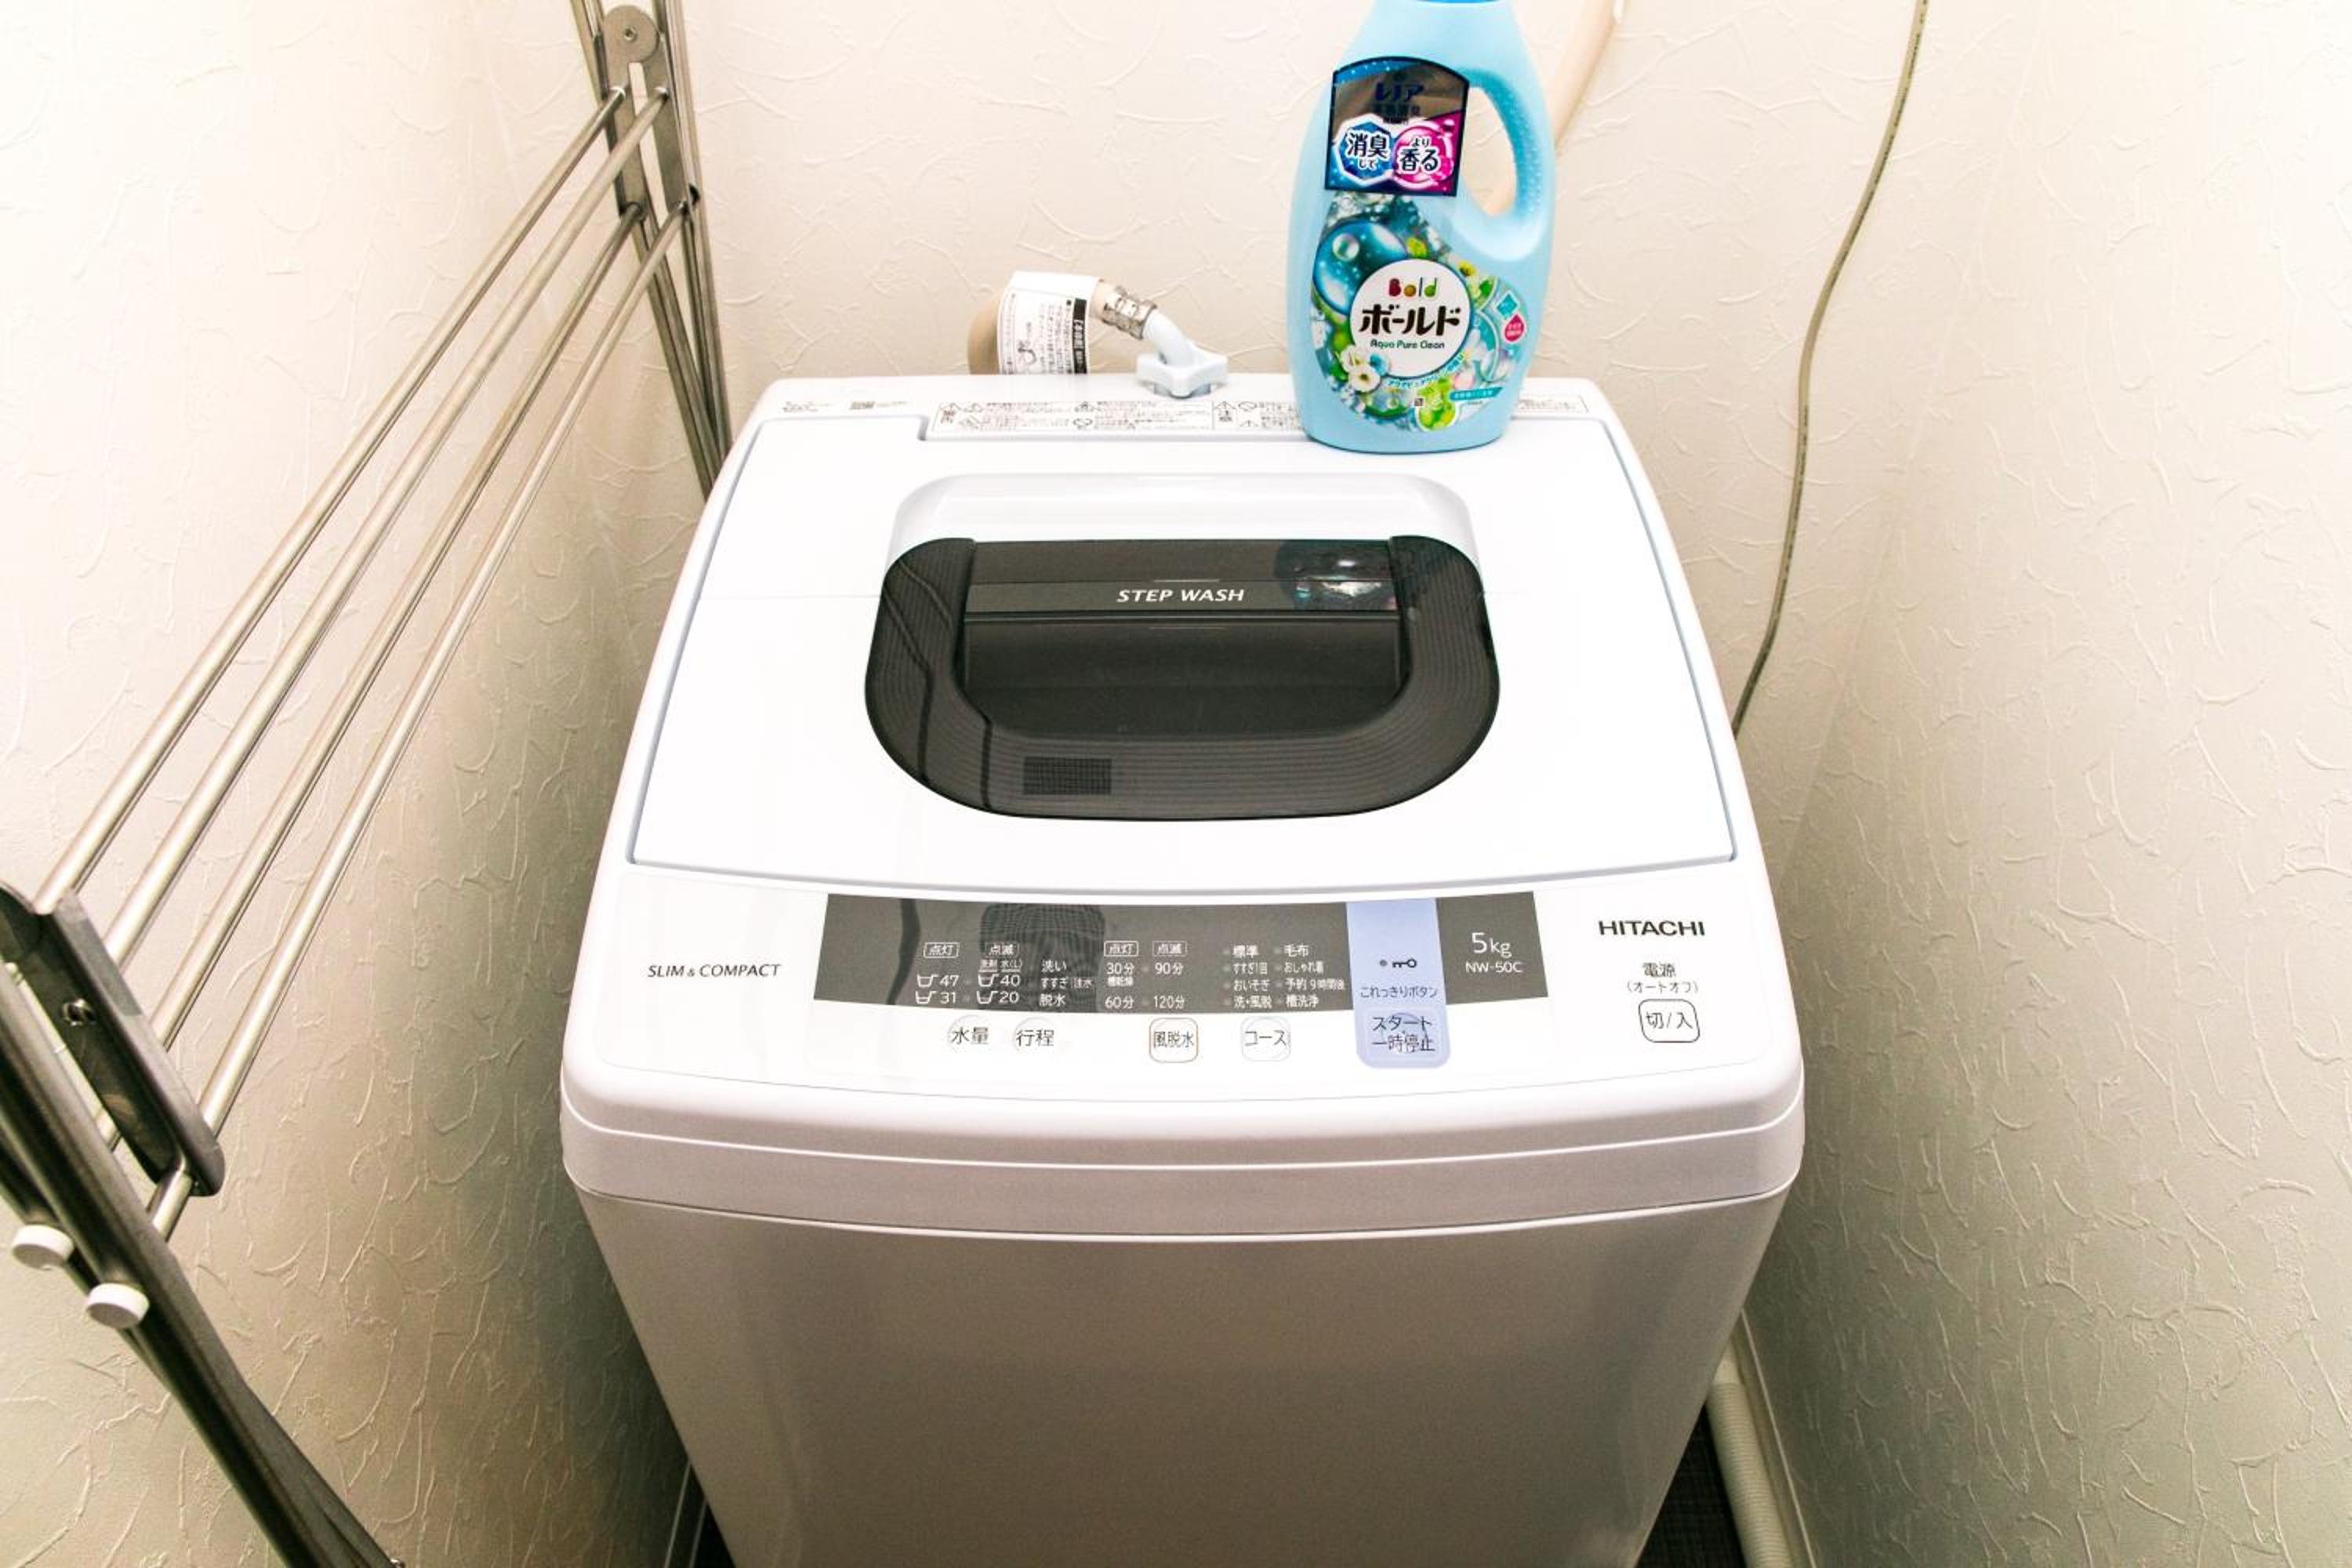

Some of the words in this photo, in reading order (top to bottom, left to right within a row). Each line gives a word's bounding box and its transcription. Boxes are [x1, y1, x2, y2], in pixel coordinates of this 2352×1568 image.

[1347, 132, 1389, 158] 消臭
[1413, 138, 1431, 147] より
[1359, 159, 1377, 169] して
[1400, 148, 1439, 171] 香る
[1388, 277, 1438, 297] Bold
[1359, 303, 1461, 336] ボールド
[1117, 589, 1173, 603] STEP
[1181, 589, 1244, 602] WASH
[1598, 920, 1706, 936] HITACHI
[648, 964, 684, 978] SLIM
[699, 964, 782, 978] COMPACT
[1041, 959, 1067, 973] 洗い
[1106, 962, 1135, 975] 30分
[1154, 962, 1184, 975] 90分
[1465, 961, 1524, 974] NW-50C
[1642, 962, 1676, 978] 電源
[939, 975, 960, 986] 47
[1000, 975, 1021, 987] 40
[940, 992, 956, 1004] 31
[999, 991, 1020, 1004] 20
[1360, 986, 1438, 999] これっきりボタン
[1039, 993, 1067, 1007] 脱水
[1105, 996, 1134, 1009] 60分
[1153, 995, 1185, 1009] 120分
[1372, 1016, 1432, 1032] スタート
[951, 1026, 989, 1046] 水量
[1015, 1029, 1054, 1047] 行程
[1152, 1030, 1196, 1049] 風脱水
[1244, 1029, 1287, 1046] コース
[1372, 1034, 1436, 1052] 一時停止
